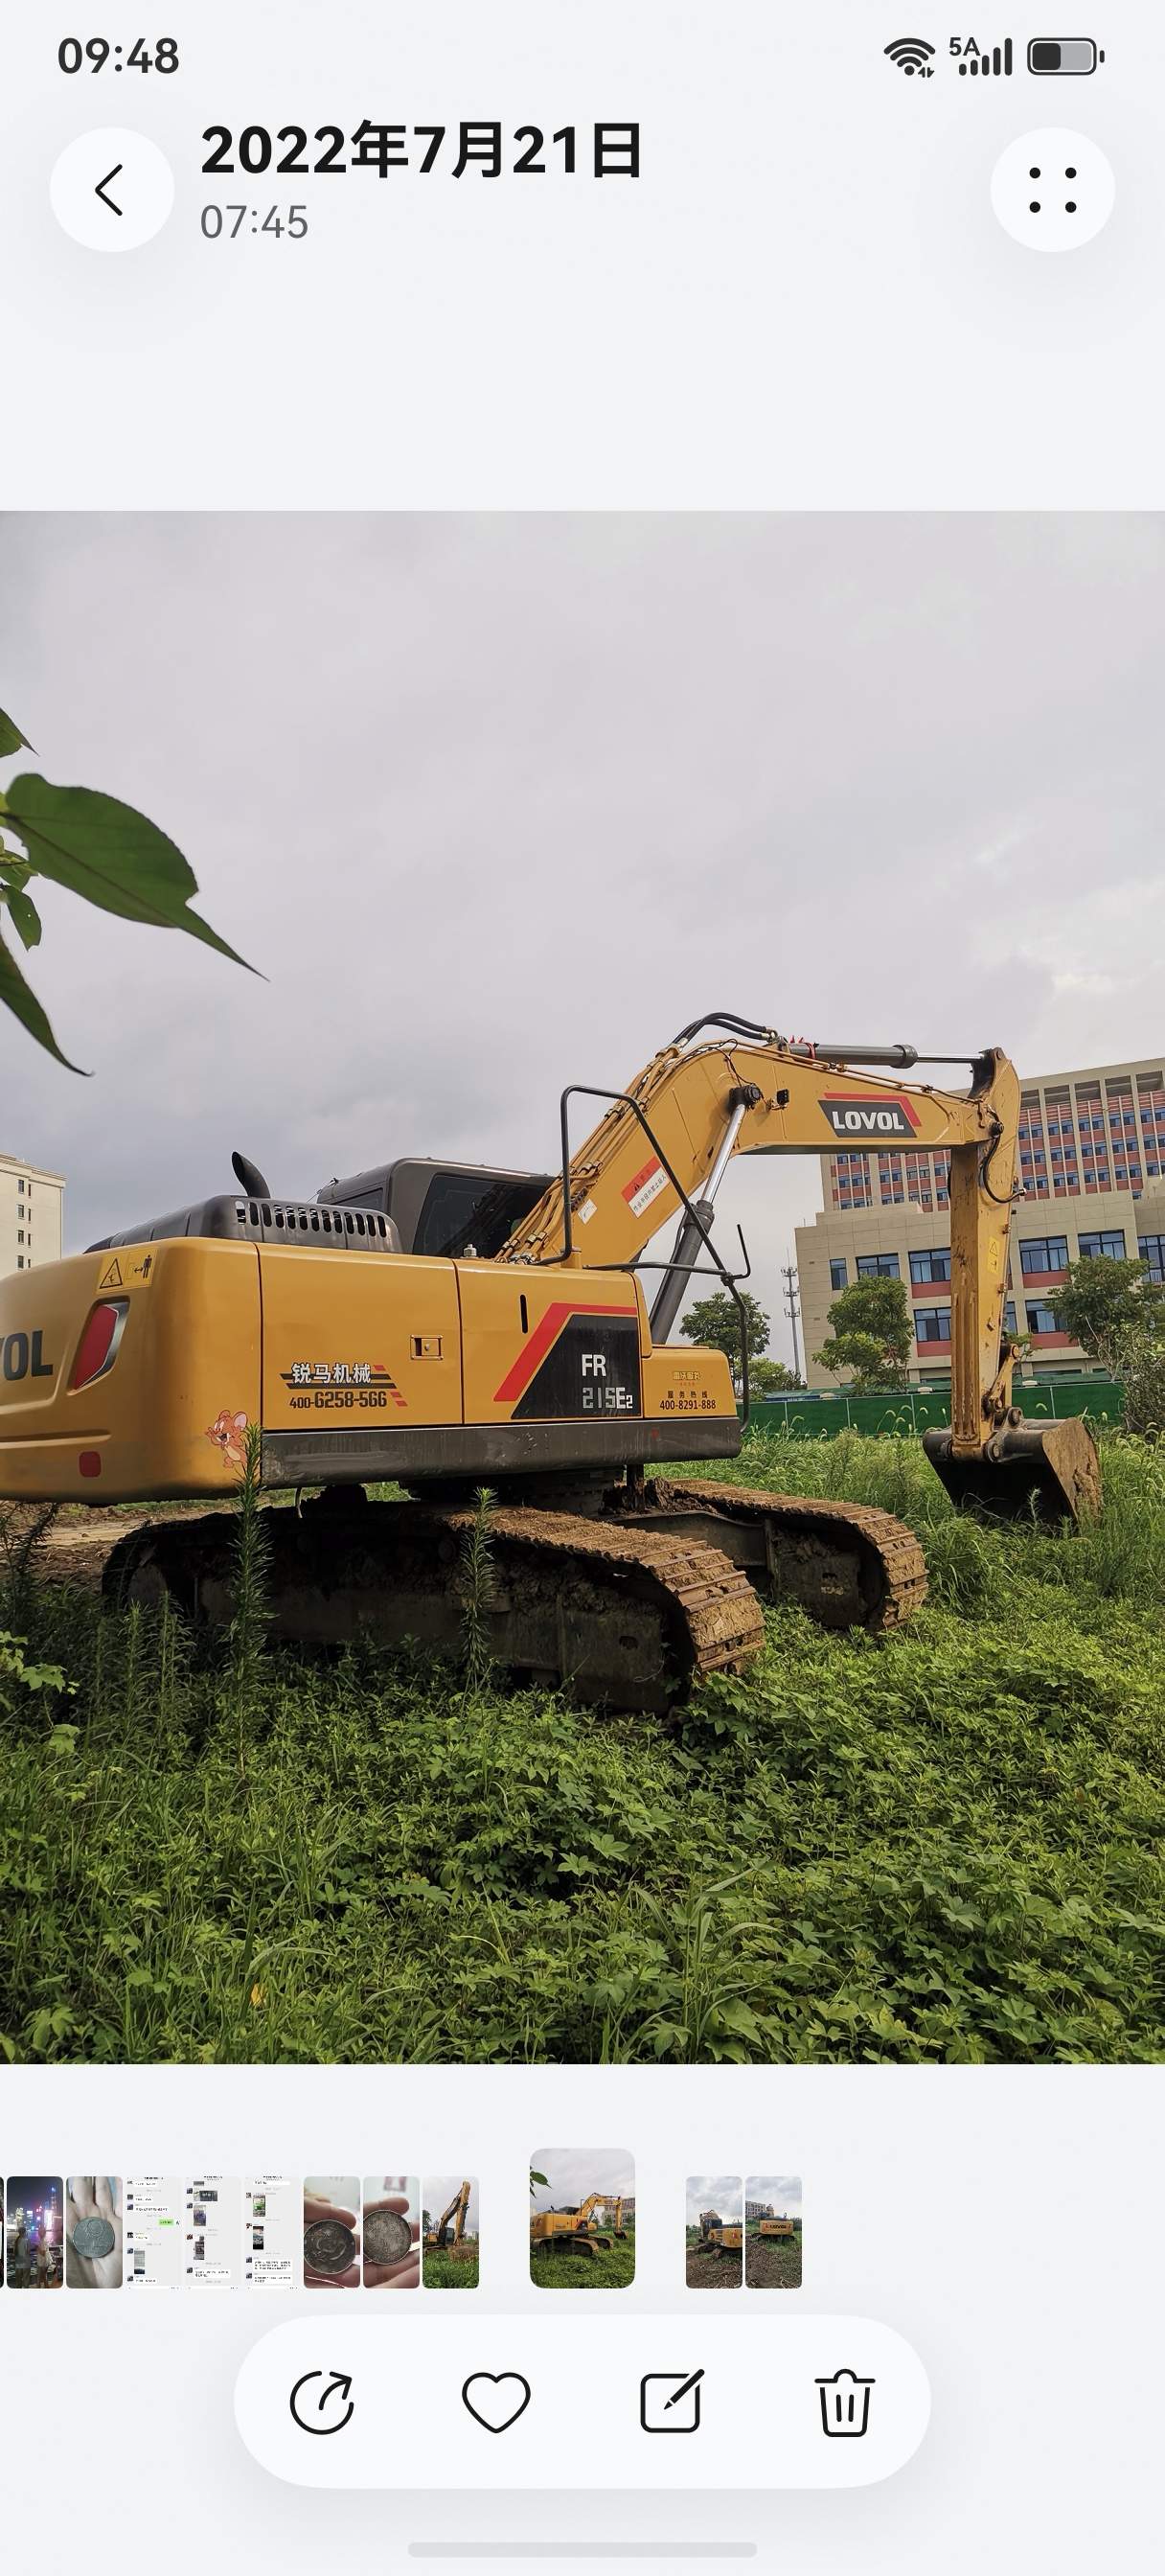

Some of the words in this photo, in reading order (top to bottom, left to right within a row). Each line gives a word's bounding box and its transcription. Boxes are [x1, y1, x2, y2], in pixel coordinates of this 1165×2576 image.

[57, 38, 180, 75] 09:48
[948, 37, 981, 55] 5A
[200, 120, 642, 179] 2022年7月21日
[200, 206, 308, 239] 07:45
[832, 1111, 904, 1131] LOVOL
[0, 1330, 53, 1381] OL
[582, 1354, 606, 1377] FR
[290, 1362, 372, 1384] 锐马机械
[289, 1392, 387, 1409] 400-6258-566
[659, 1400, 717, 1410] 400-8291-888
